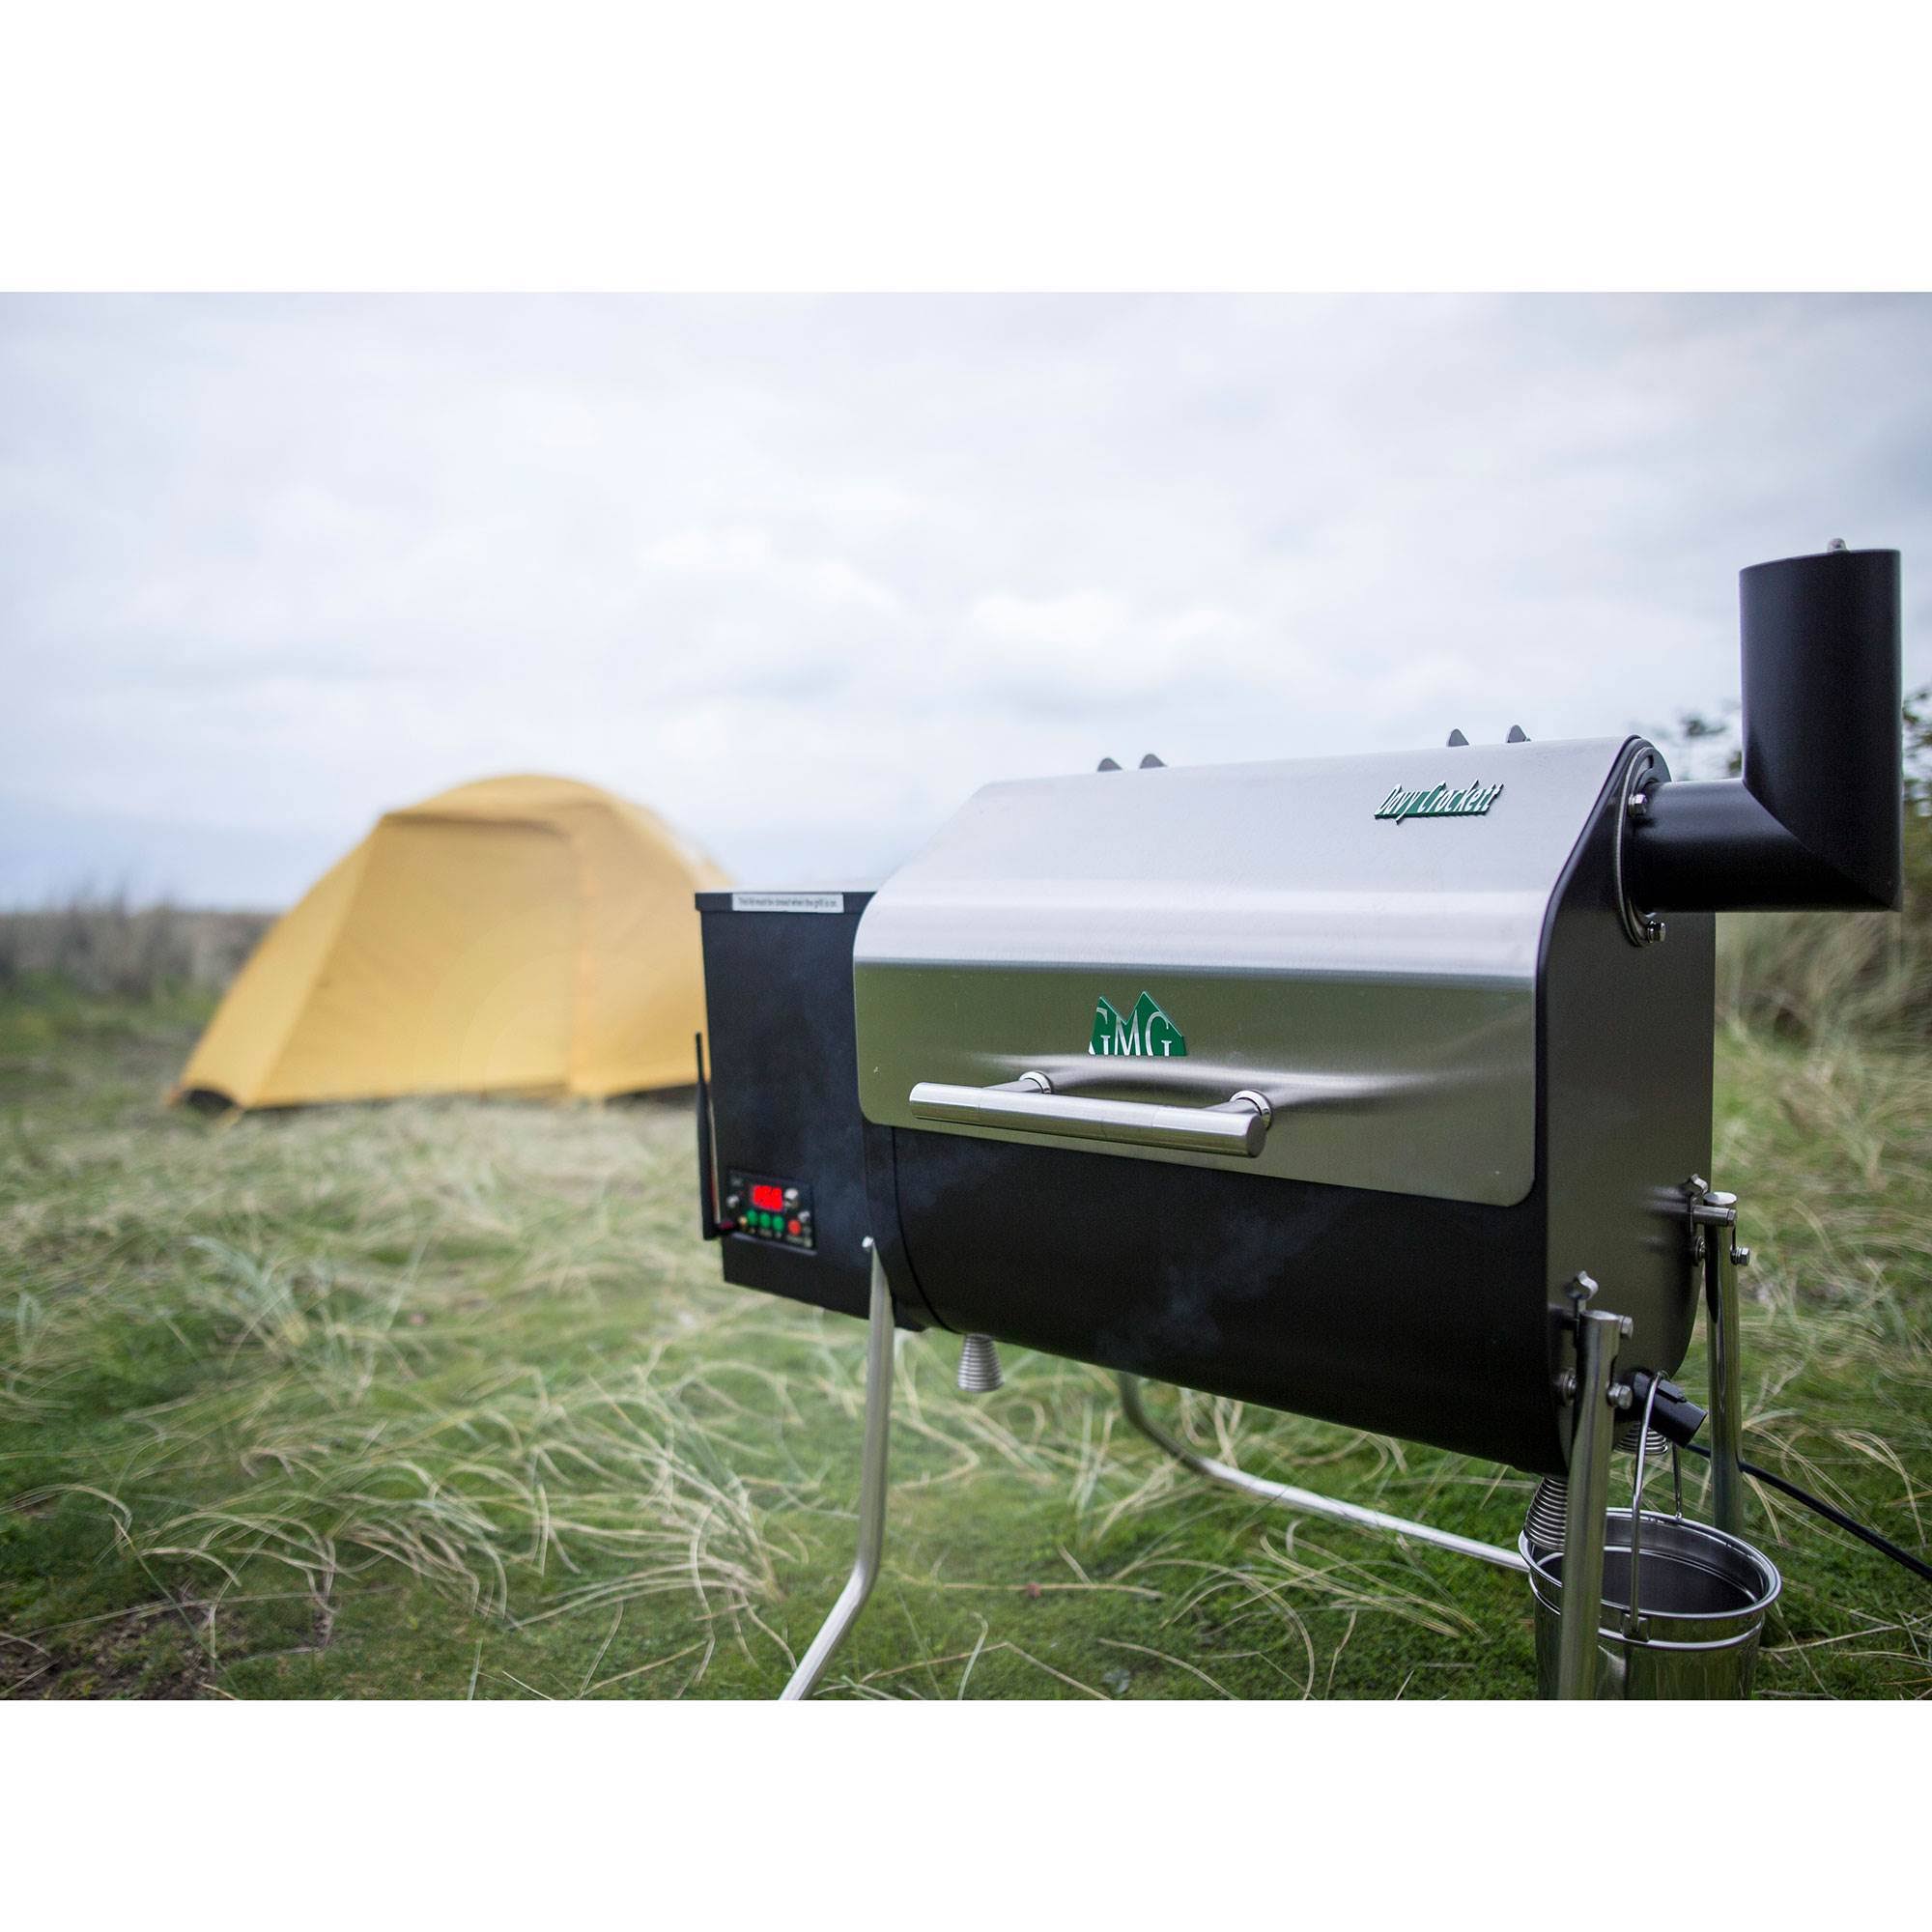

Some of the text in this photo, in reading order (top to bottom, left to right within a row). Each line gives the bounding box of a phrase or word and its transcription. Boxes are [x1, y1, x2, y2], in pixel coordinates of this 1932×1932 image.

[1374, 780, 1504, 821] Davy Crockett
[1088, 1007, 1173, 1057] GMG
